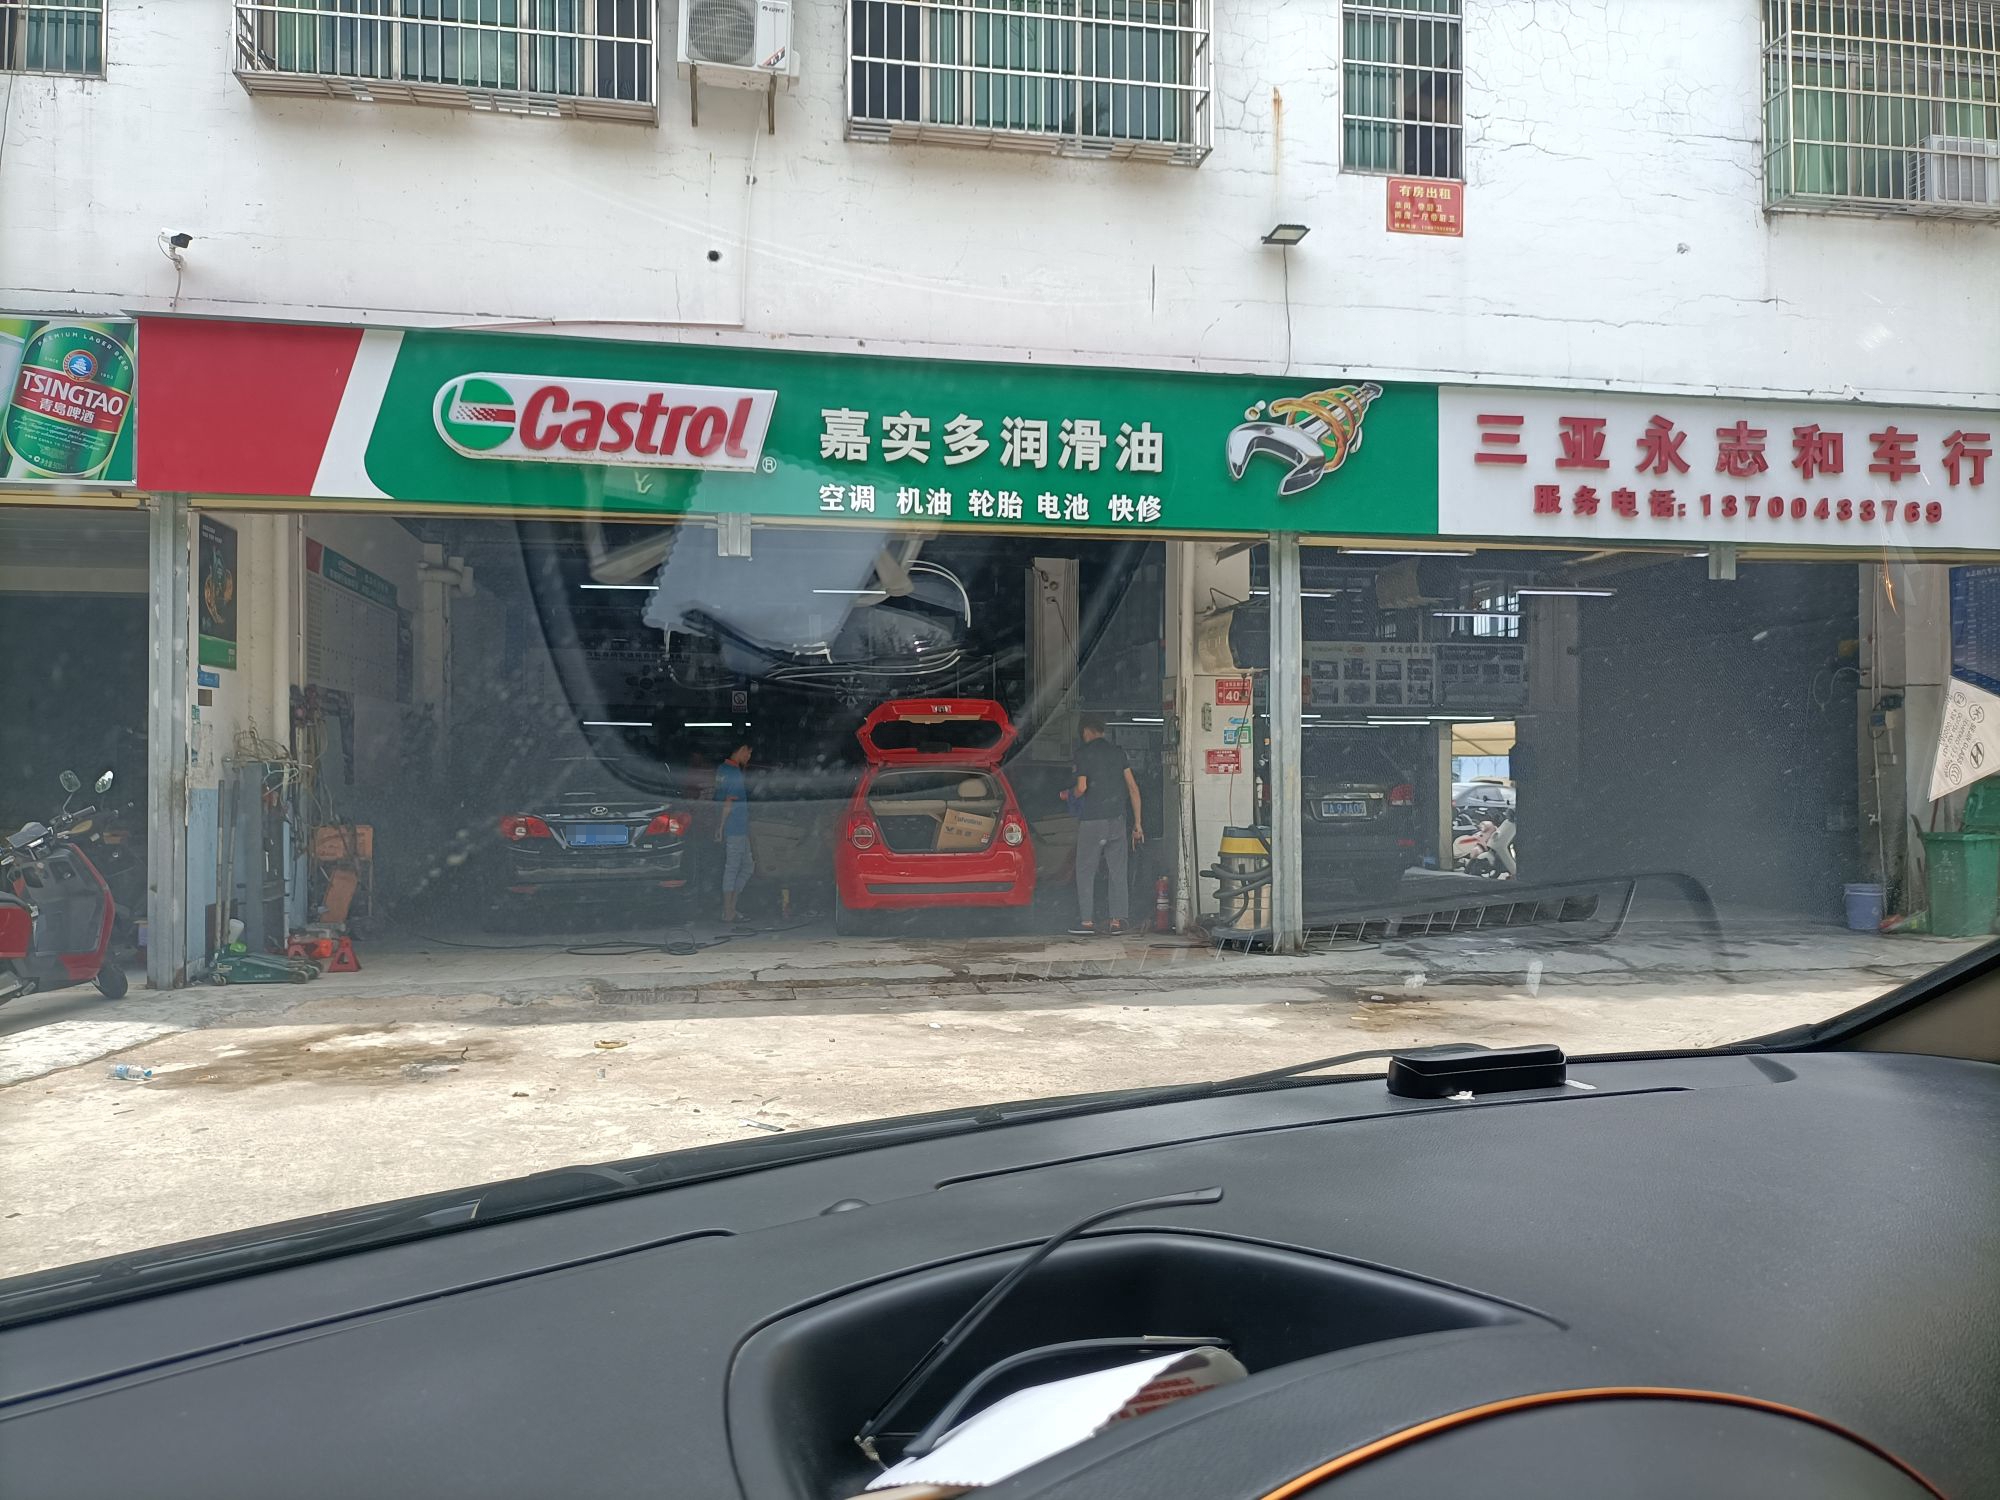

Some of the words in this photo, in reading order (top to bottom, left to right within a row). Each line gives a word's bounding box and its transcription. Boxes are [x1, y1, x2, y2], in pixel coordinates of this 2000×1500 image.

[1399, 185, 1451, 199] 有房出租
[83, 334, 112, 350] LAGER
[114, 350, 129, 370] BEER
[22, 370, 124, 415] TSINGTAO
[39, 398, 95, 424] 青岛啤酒
[519, 385, 753, 458] Castrol
[820, 407, 1164, 473] 嘉实多润滑油
[1474, 414, 1993, 487] 三亚永志和车行
[818, 484, 875, 513] 空调
[896, 487, 952, 516] 机油
[968, 489, 1023, 519] 轮胎
[1037, 491, 1089, 521] 电池
[1108, 494, 1162, 523] 快修
[1957, 743, 1970, 765] GLASS
